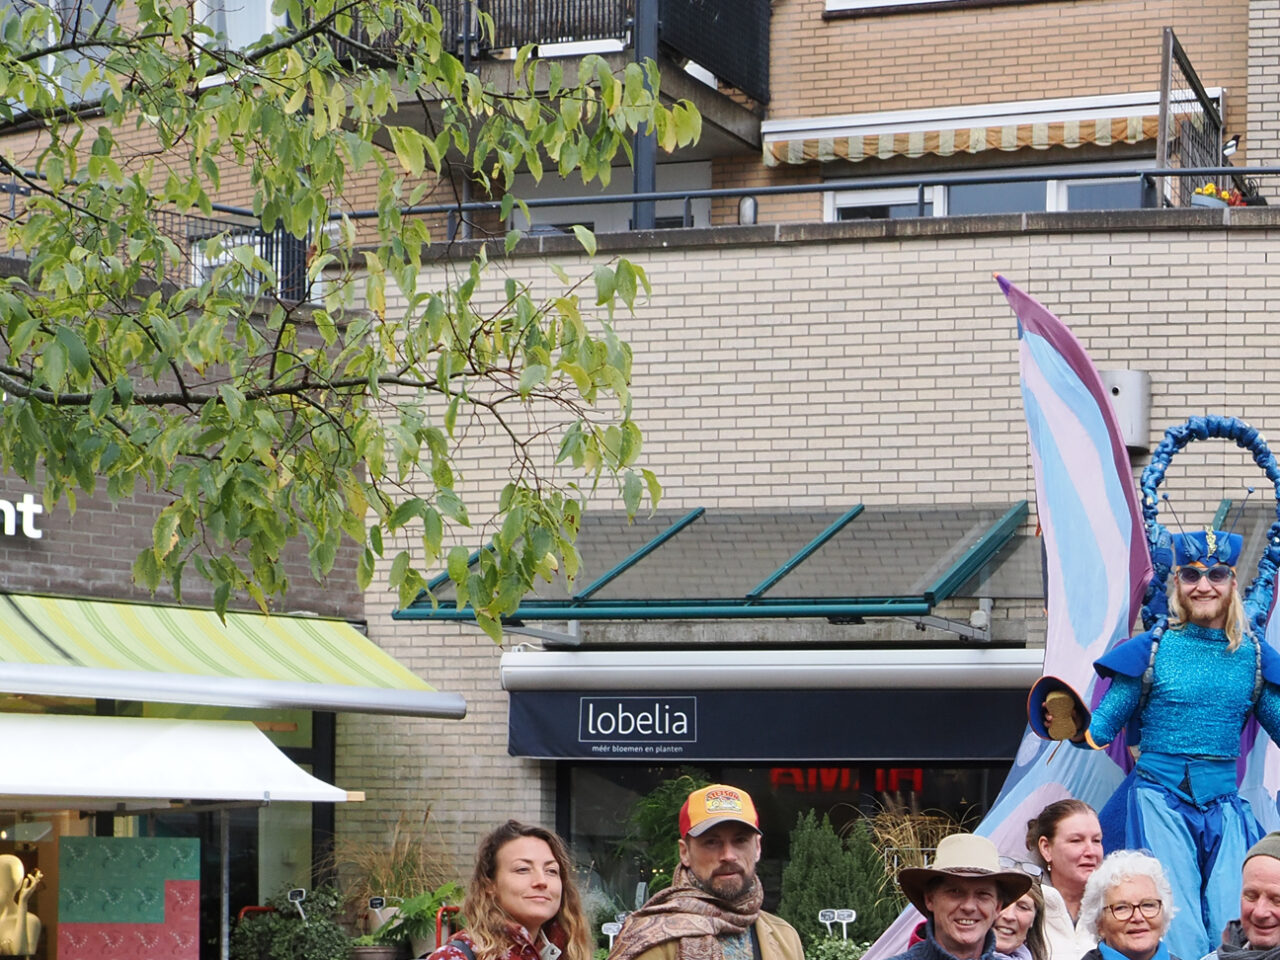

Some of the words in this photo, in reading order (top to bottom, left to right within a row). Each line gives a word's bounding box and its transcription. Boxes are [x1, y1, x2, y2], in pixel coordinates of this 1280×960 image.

[588, 703, 688, 734] lobelia
[612, 745, 643, 753] bloemen
[655, 745, 683, 754] planten
[707, 790, 739, 800] STETSON
